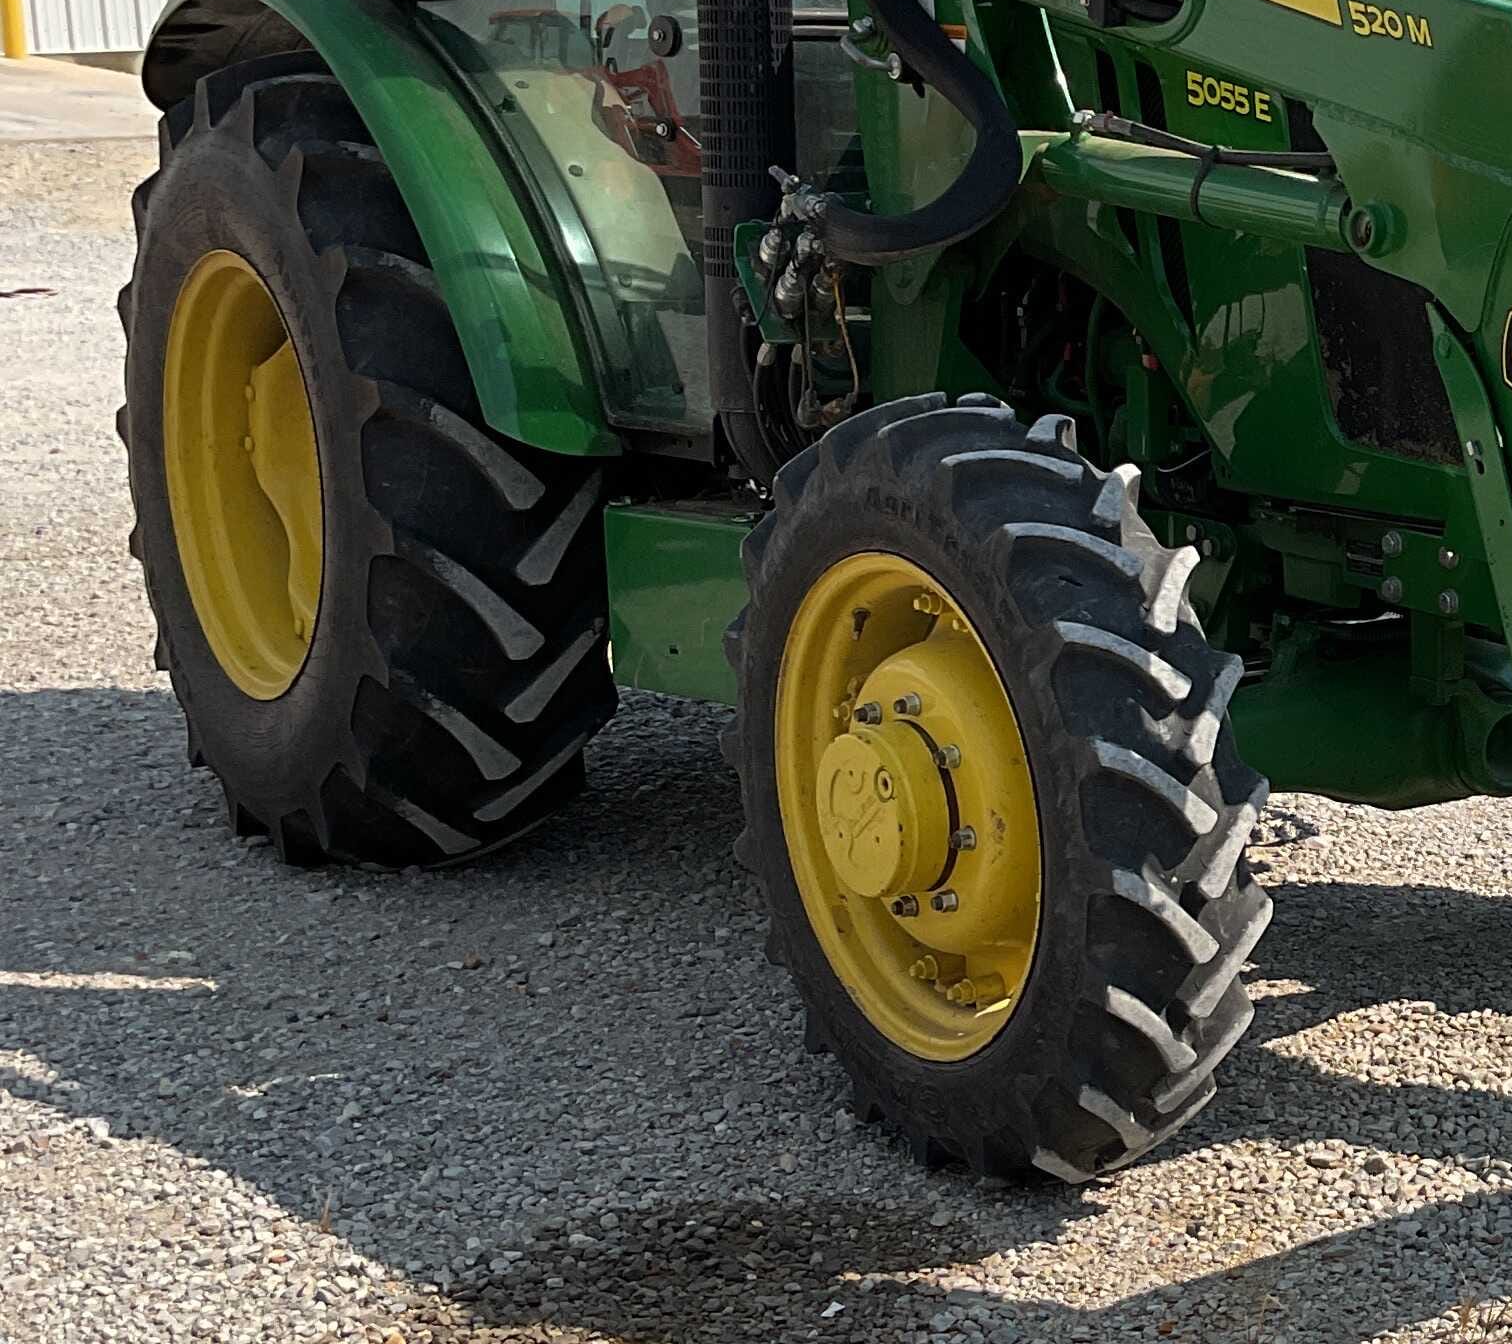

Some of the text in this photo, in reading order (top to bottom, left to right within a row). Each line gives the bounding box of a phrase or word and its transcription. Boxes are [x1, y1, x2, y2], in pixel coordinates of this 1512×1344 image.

[1347, 0, 1433, 48] 520 M
[1186, 70, 1273, 123] 5055 E
